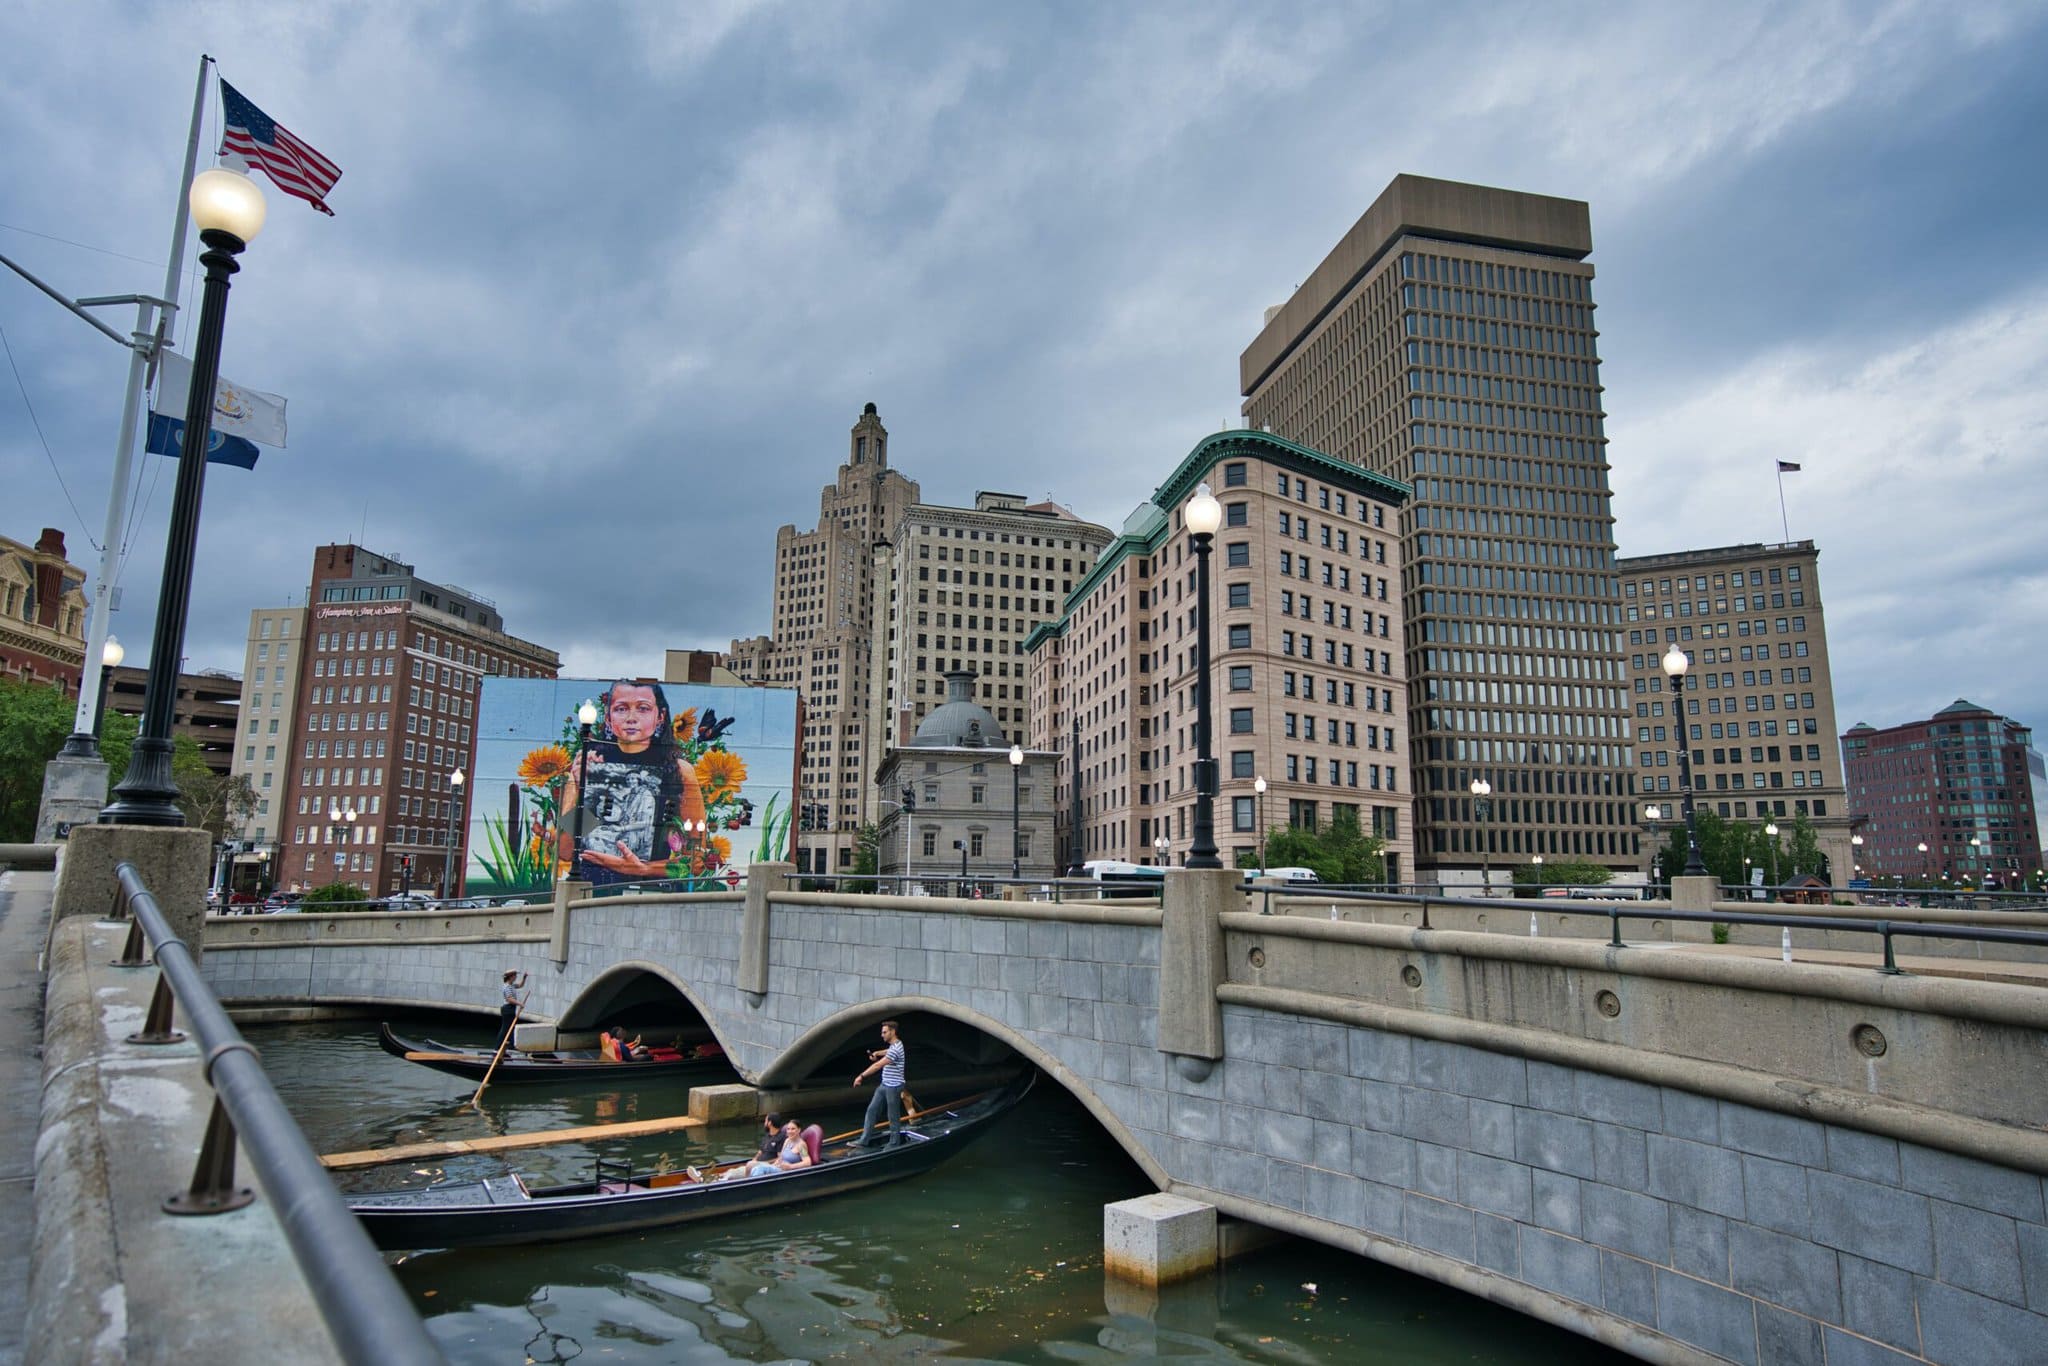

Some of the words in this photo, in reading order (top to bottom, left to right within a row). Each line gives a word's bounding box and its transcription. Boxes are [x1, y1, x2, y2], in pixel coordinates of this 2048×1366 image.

[317, 607, 356, 619] Hampton
[356, 606, 374, 616] Inn
[381, 605, 402, 615] Suites
